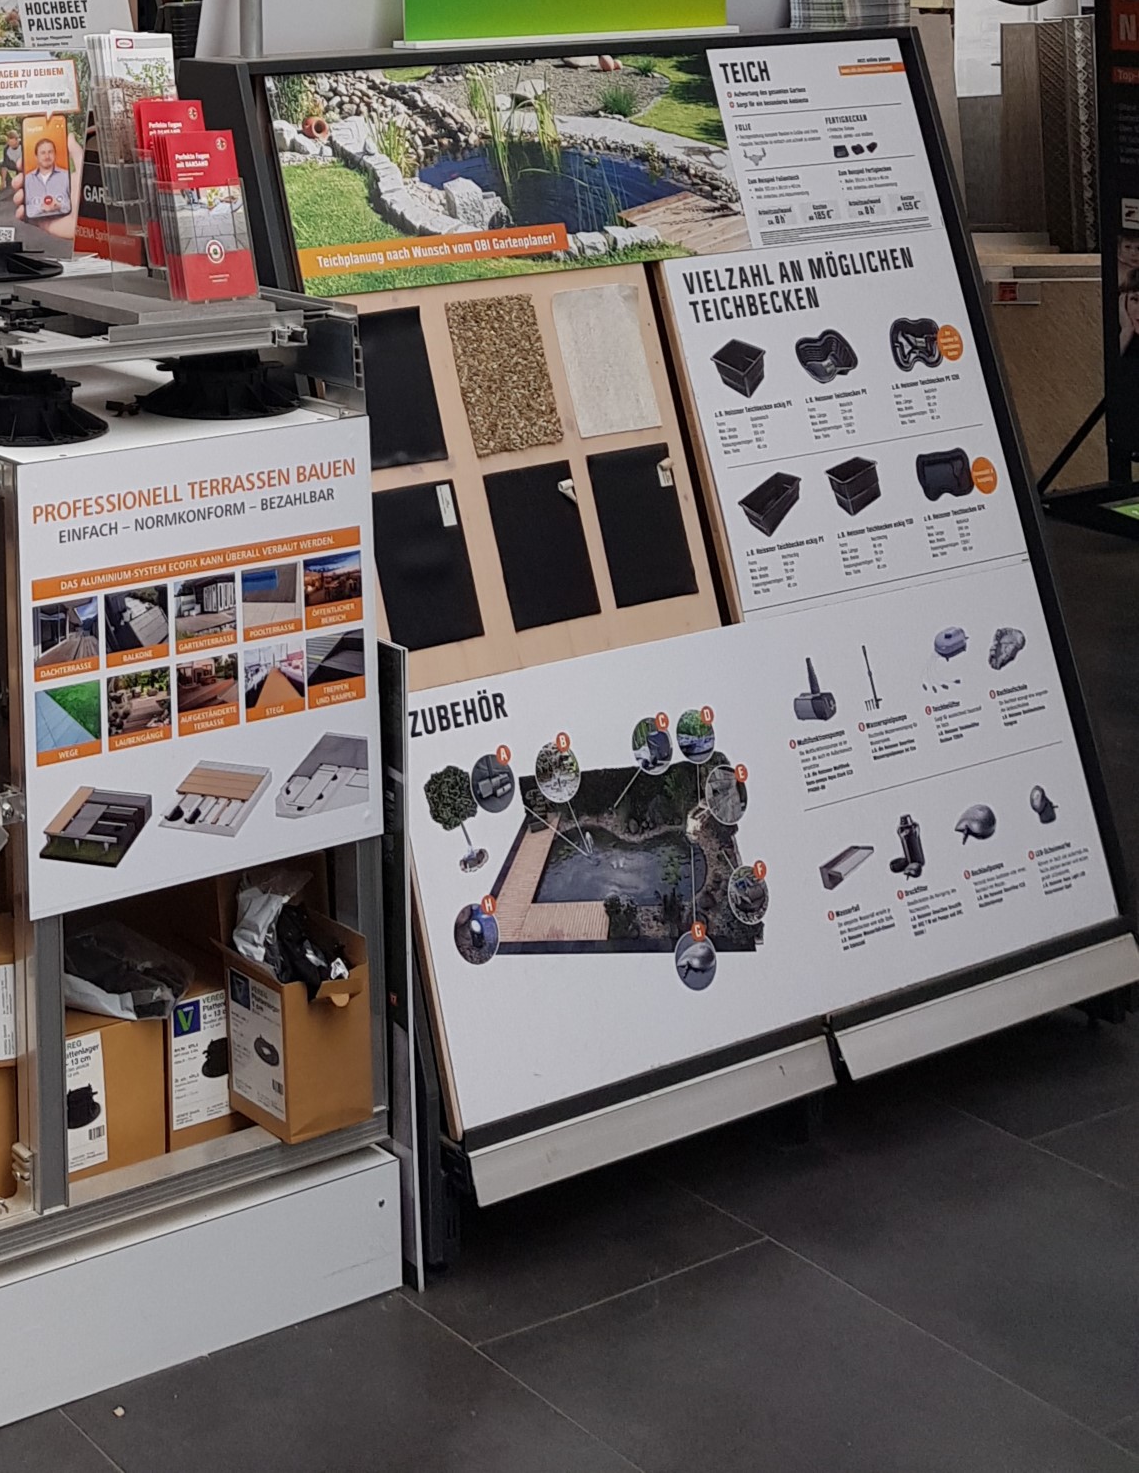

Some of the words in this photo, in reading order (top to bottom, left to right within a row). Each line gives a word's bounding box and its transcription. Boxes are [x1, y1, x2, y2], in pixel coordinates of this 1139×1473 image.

[25, 0, 88, 15] HOCHBEET
[28, 15, 87, 31] PALISADE
[21, 69, 31, 77] ZU
[34, 67, 64, 76] DEINEM
[719, 60, 771, 83] TEICH
[316, 250, 384, 268] Teichplanung
[386, 246, 410, 262] nach
[412, 242, 451, 258] Wunsch
[452, 243, 472, 254] vom
[474, 238, 491, 251] OBI
[492, 232, 556, 250] Gartenplaner!
[682, 263, 775, 295] VIELZAHL
[779, 259, 804, 283] AN
[807, 246, 914, 279] MÖGLICHEN
[689, 286, 820, 324] TEICHBECKEN
[32, 484, 183, 525] PROFESSIONELL
[187, 467, 290, 500] TERRASSEN
[296, 457, 356, 484] BAUEN
[59, 522, 119, 544] EINFACH
[134, 501, 245, 532] NORMKONFORM
[261, 488, 335, 511] BEZAHLBAR
[60, 578, 78, 591] DAS
[80, 565, 167, 588] ALUMINIUM-SYSTEM
[168, 558, 198, 572] ECOFIX
[200, 553, 224, 568] KANN
[225, 546, 260, 563] ÜBERALL
[262, 541, 298, 557] VERBAUT
[299, 536, 335, 551] WERDEN.
[178, 633, 235, 651] GARTENTERRASSE
[122, 650, 153, 662] BALKONE
[40, 661, 92, 678] DACHTERRASSE
[265, 705, 285, 716] STEGE
[408, 690, 508, 738] ZUBEHÖR
[703, 708, 711, 721] D
[658, 715, 665, 728] C
[560, 735, 567, 748] B
[58, 748, 79, 759] WEGE
[500, 749, 508, 760] A
[738, 766, 745, 779] E
[757, 863, 764, 876] F
[484, 898, 493, 912] H
[694, 925, 702, 937] G
[71, 1059, 79, 1067] 13
[80, 1055, 91, 1063] cm
